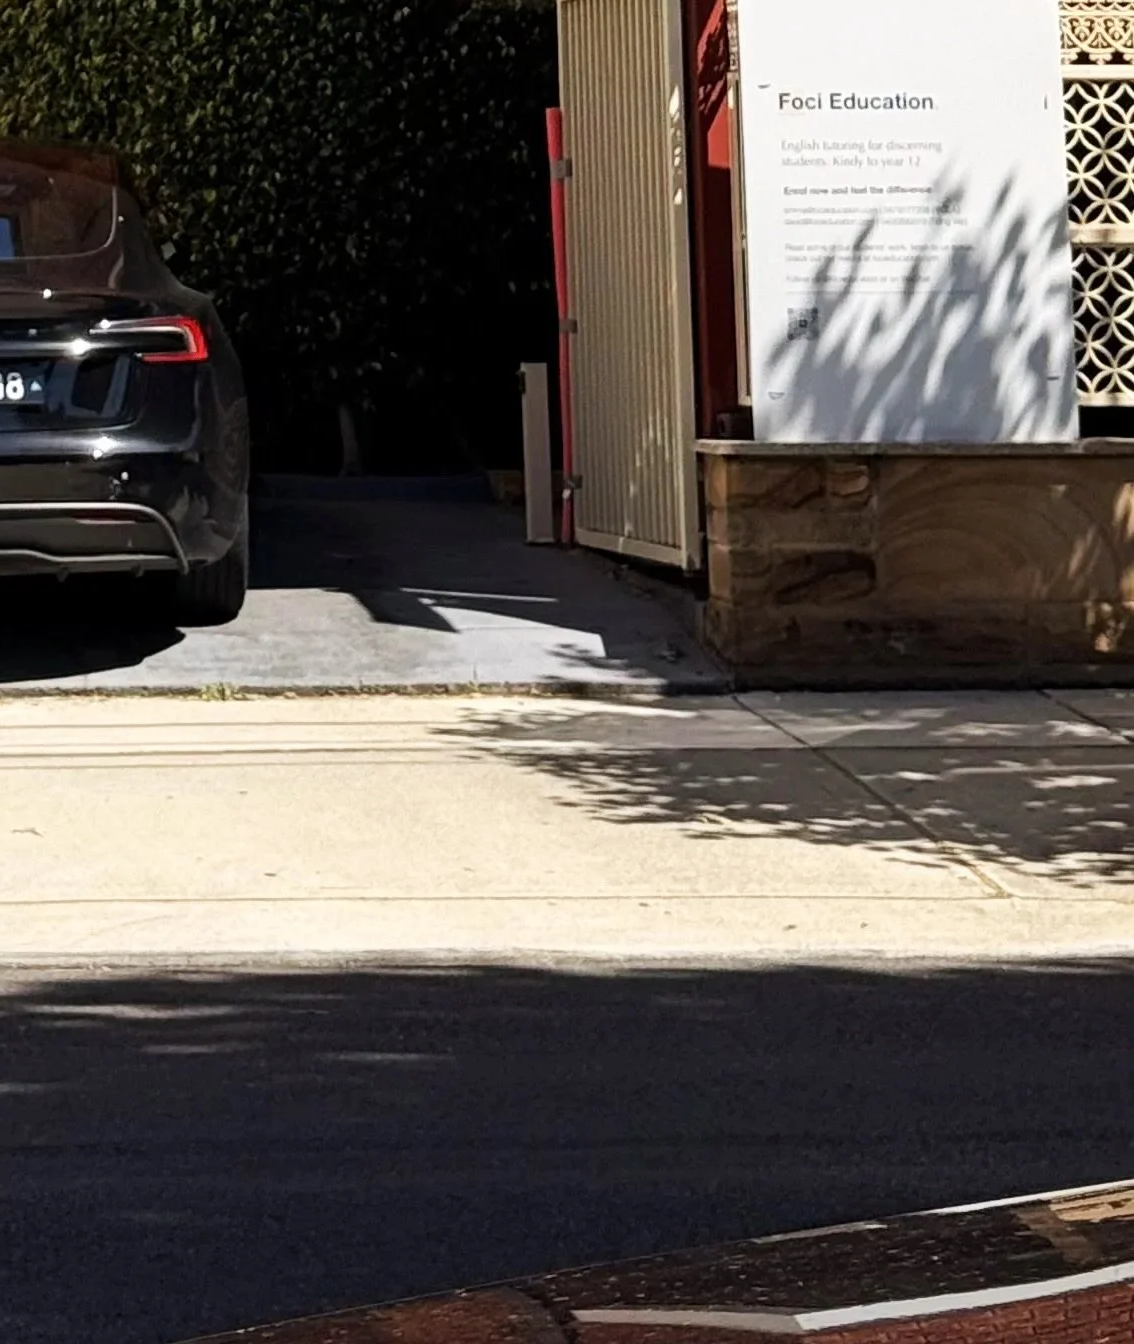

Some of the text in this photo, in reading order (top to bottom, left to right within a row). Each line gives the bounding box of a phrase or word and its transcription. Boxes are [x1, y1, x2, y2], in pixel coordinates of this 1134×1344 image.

[778, 92, 934, 110] Foci Education
[781, 139, 819, 153] English
[868, 139, 883, 150] for
